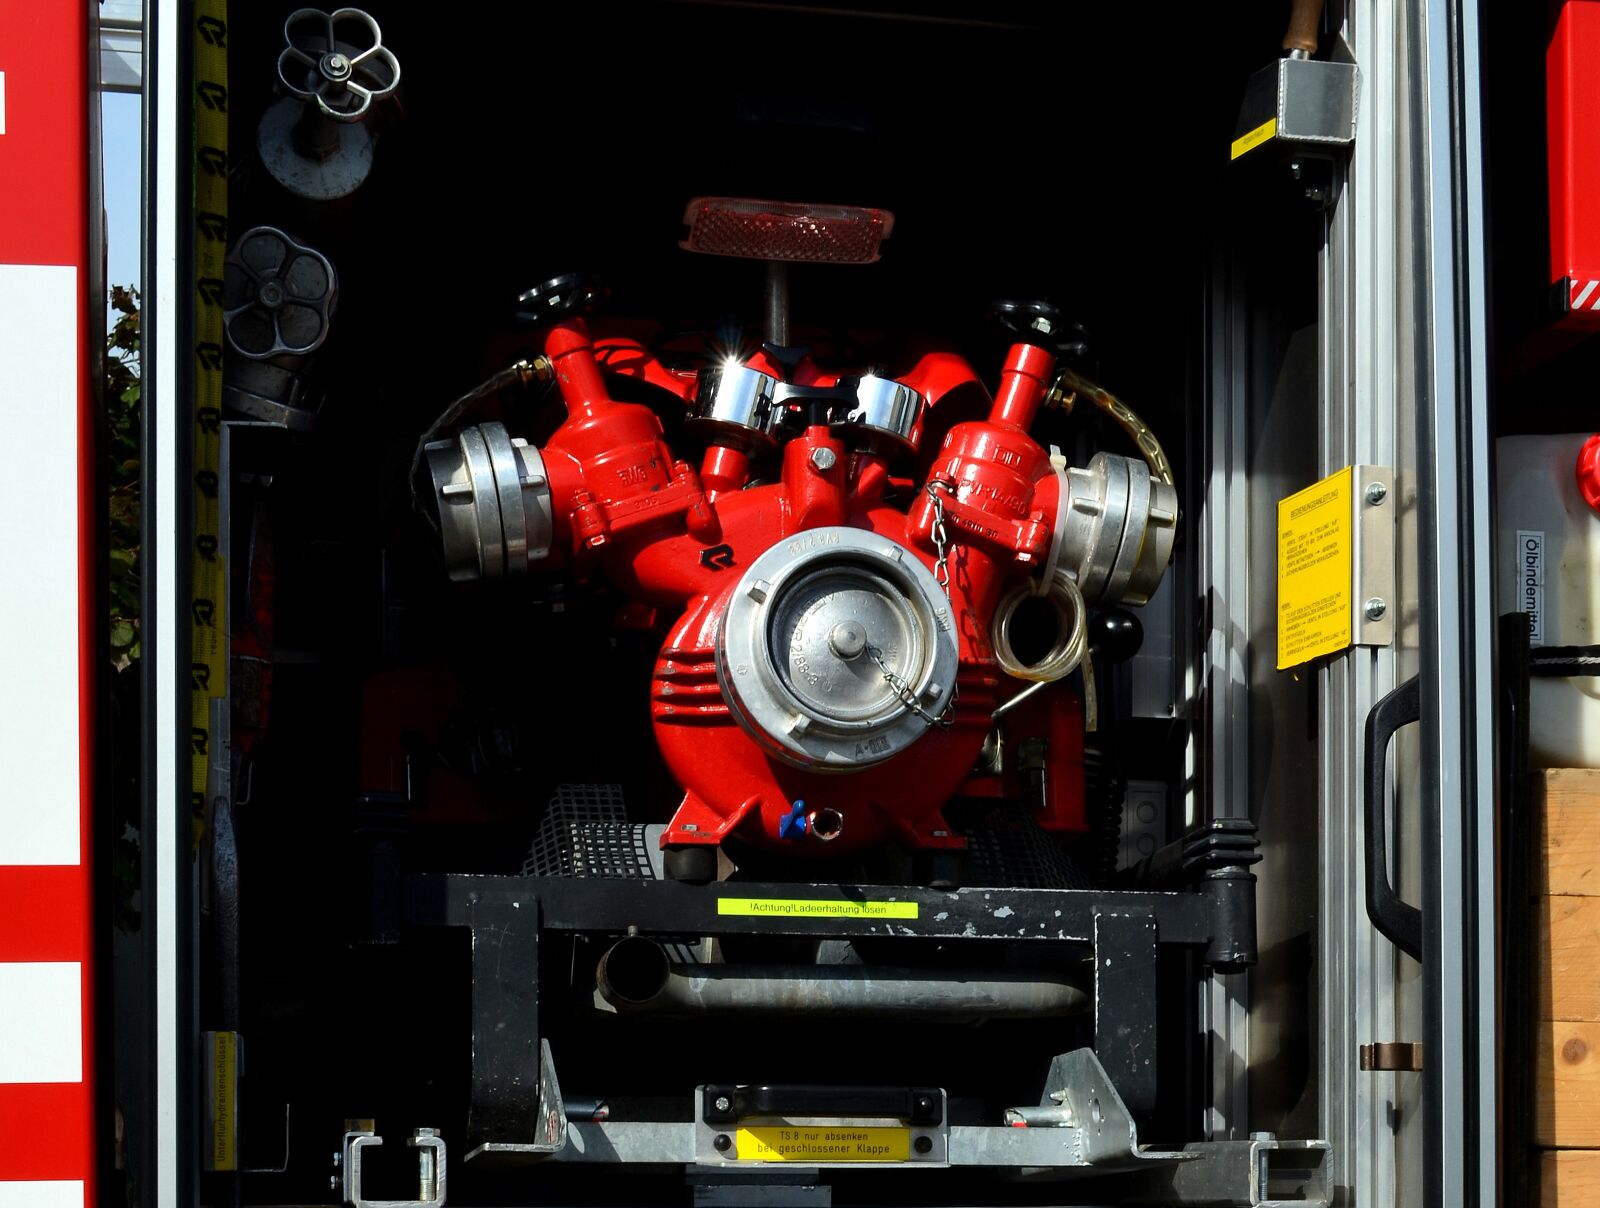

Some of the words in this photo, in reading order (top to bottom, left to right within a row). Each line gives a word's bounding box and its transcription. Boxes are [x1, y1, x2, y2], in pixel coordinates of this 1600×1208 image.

[1525, 539, 1540, 637] Ölbindemittel
[780, 1131, 791, 1141] TS
[794, 1131, 799, 1141] 8
[804, 1132, 819, 1141] nur
[825, 1131, 868, 1141] absenken
[757, 1143, 773, 1153] bei
[778, 1144, 850, 1155] geschlossener
[857, 1143, 890, 1155] Klappe
